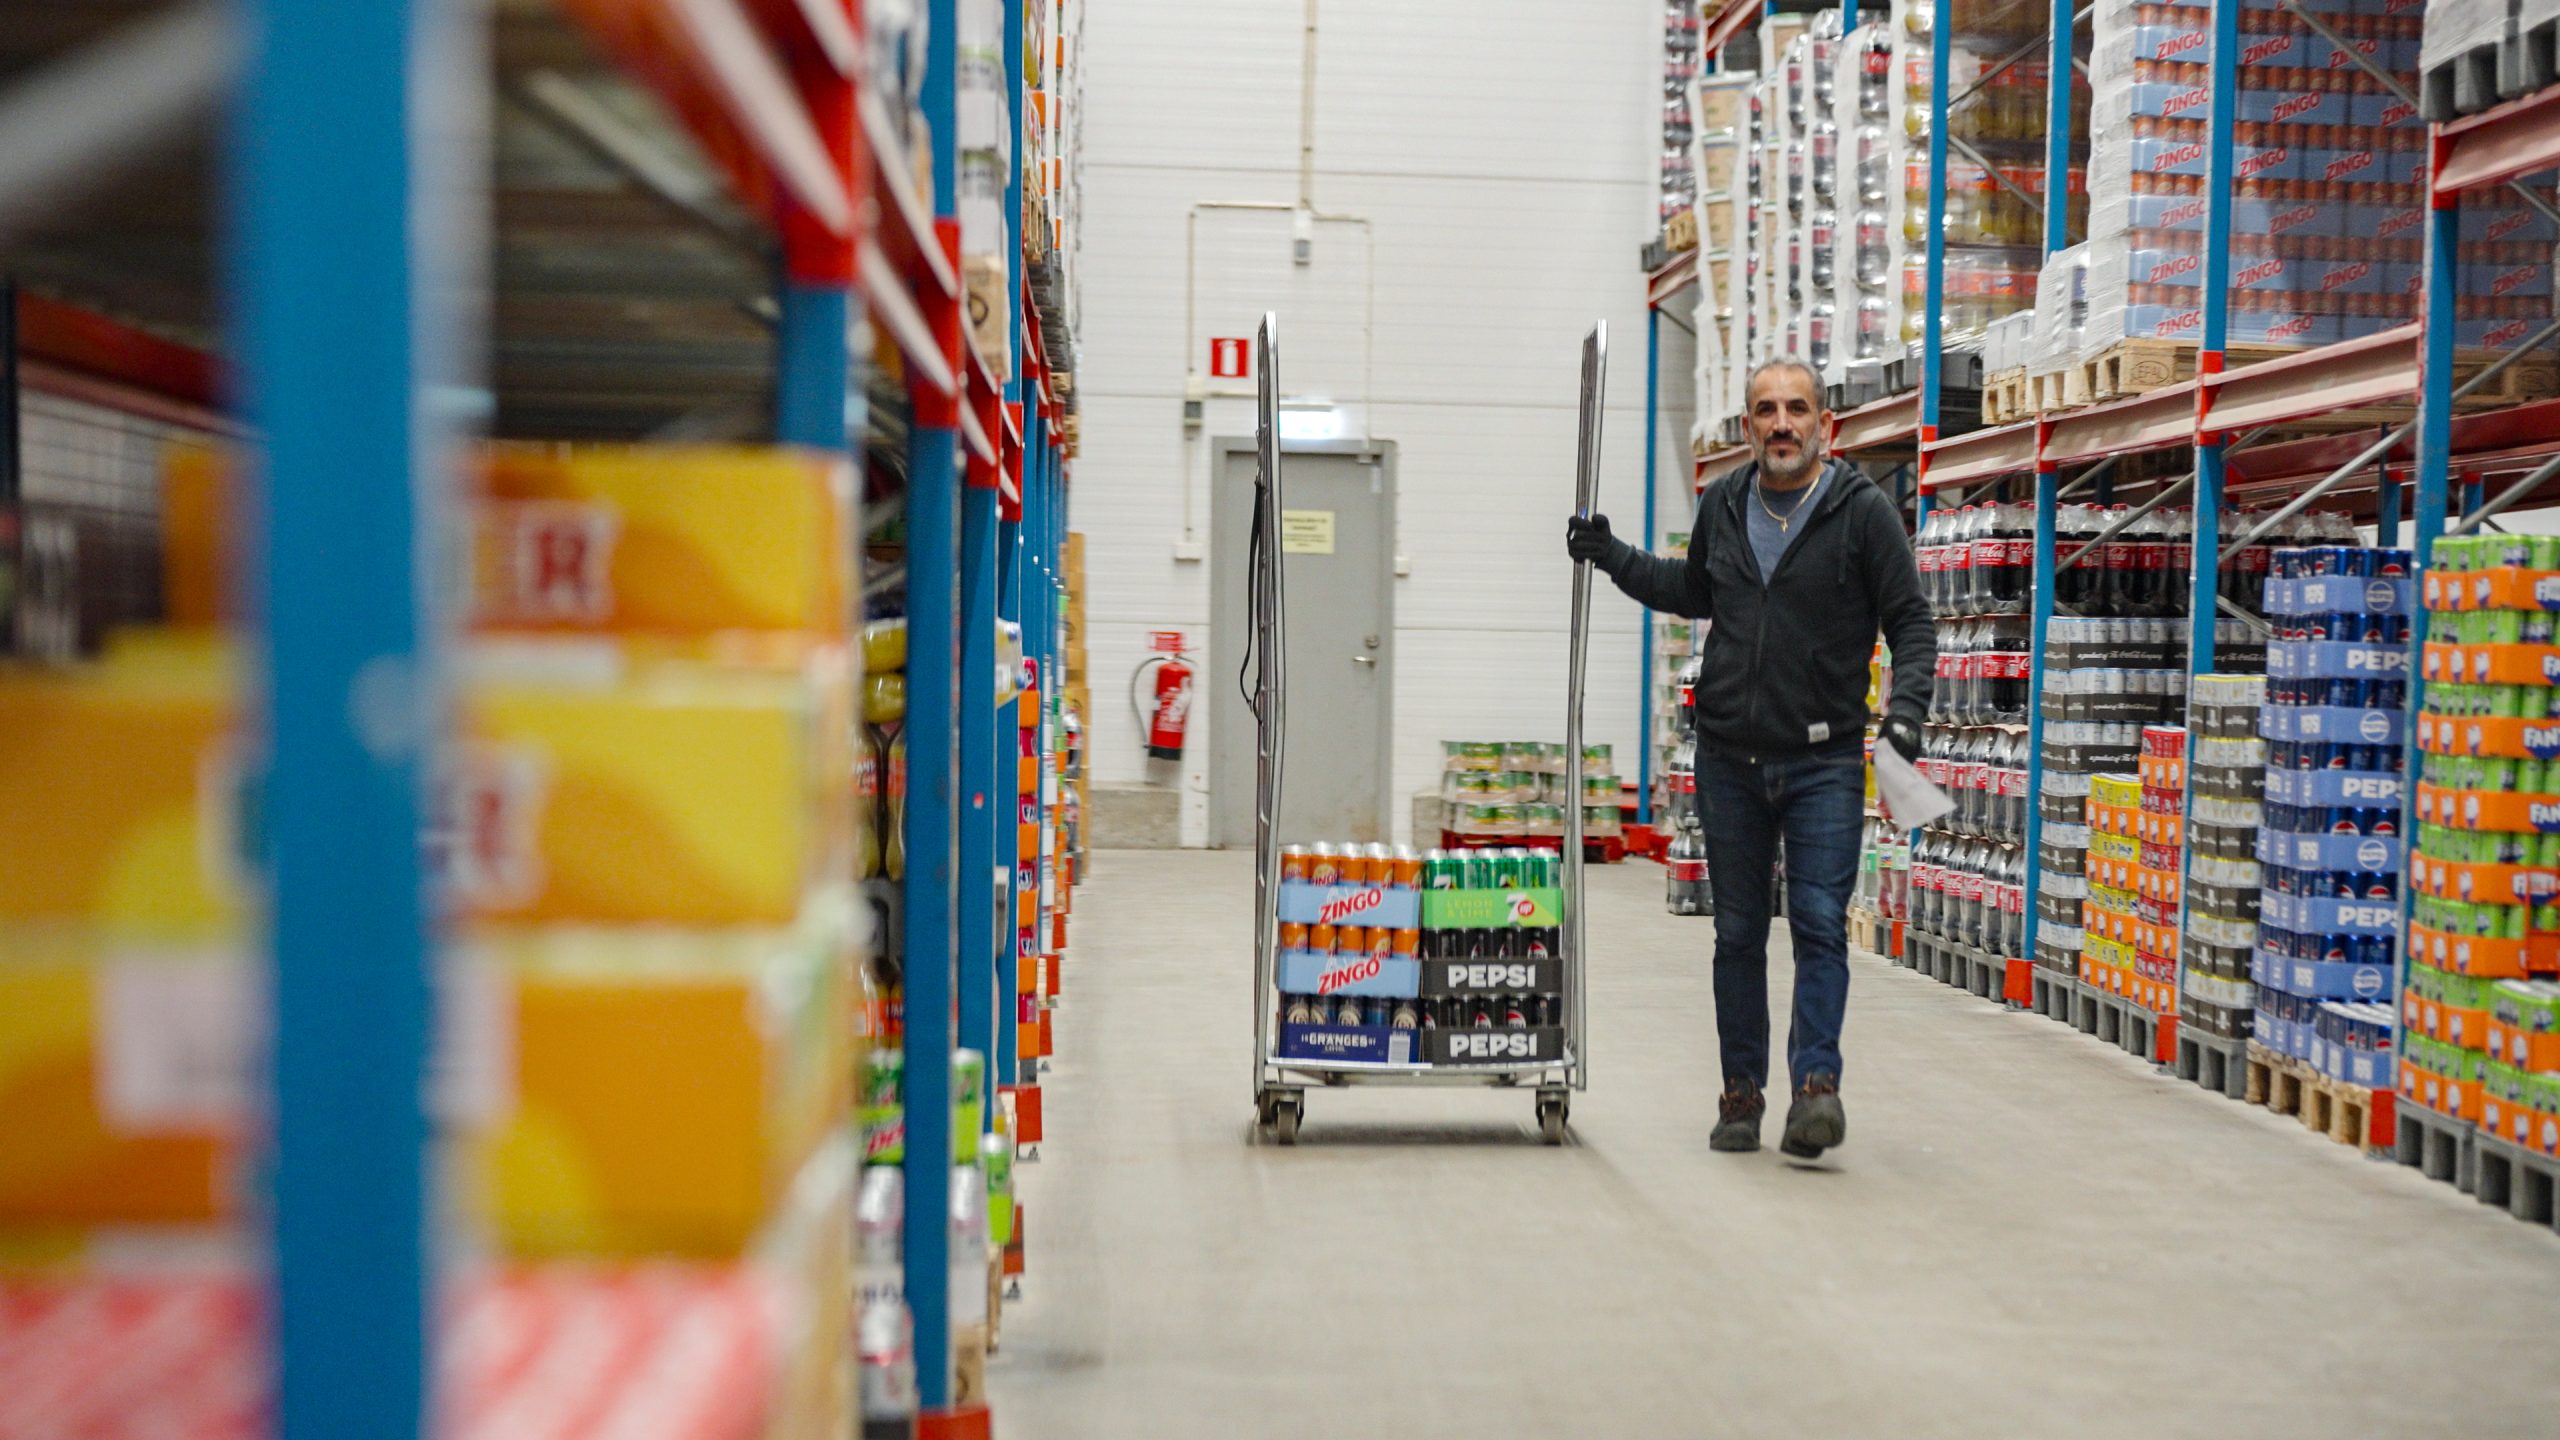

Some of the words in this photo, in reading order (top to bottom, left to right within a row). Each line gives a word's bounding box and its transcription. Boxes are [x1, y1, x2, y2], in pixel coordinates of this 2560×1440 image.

[2156, 31, 2206, 60] ZINGO
[2243, 34, 2293, 65] ZINGO
[2271, 91, 2321, 124] ZINGO
[2154, 143, 2202, 172] ZINGO
[2239, 147, 2288, 177] ZINGO
[2324, 151, 2373, 181] ZINGO
[2269, 205, 2318, 237] ZINGO
[2149, 255, 2198, 284] ZINGO
[2235, 258, 2285, 289] ZINGO
[2321, 262, 2370, 292] ZINGO
[2491, 265, 2539, 296] ZINGO
[2265, 313, 2314, 344] ZINGO
[2482, 319, 2530, 350] ZINGO
[1319, 888, 1382, 925] ZINGO
[1318, 958, 1381, 995] ZINGO
[1448, 964, 1536, 988] PEPSI
[1450, 1033, 1537, 1057] PEPSI
